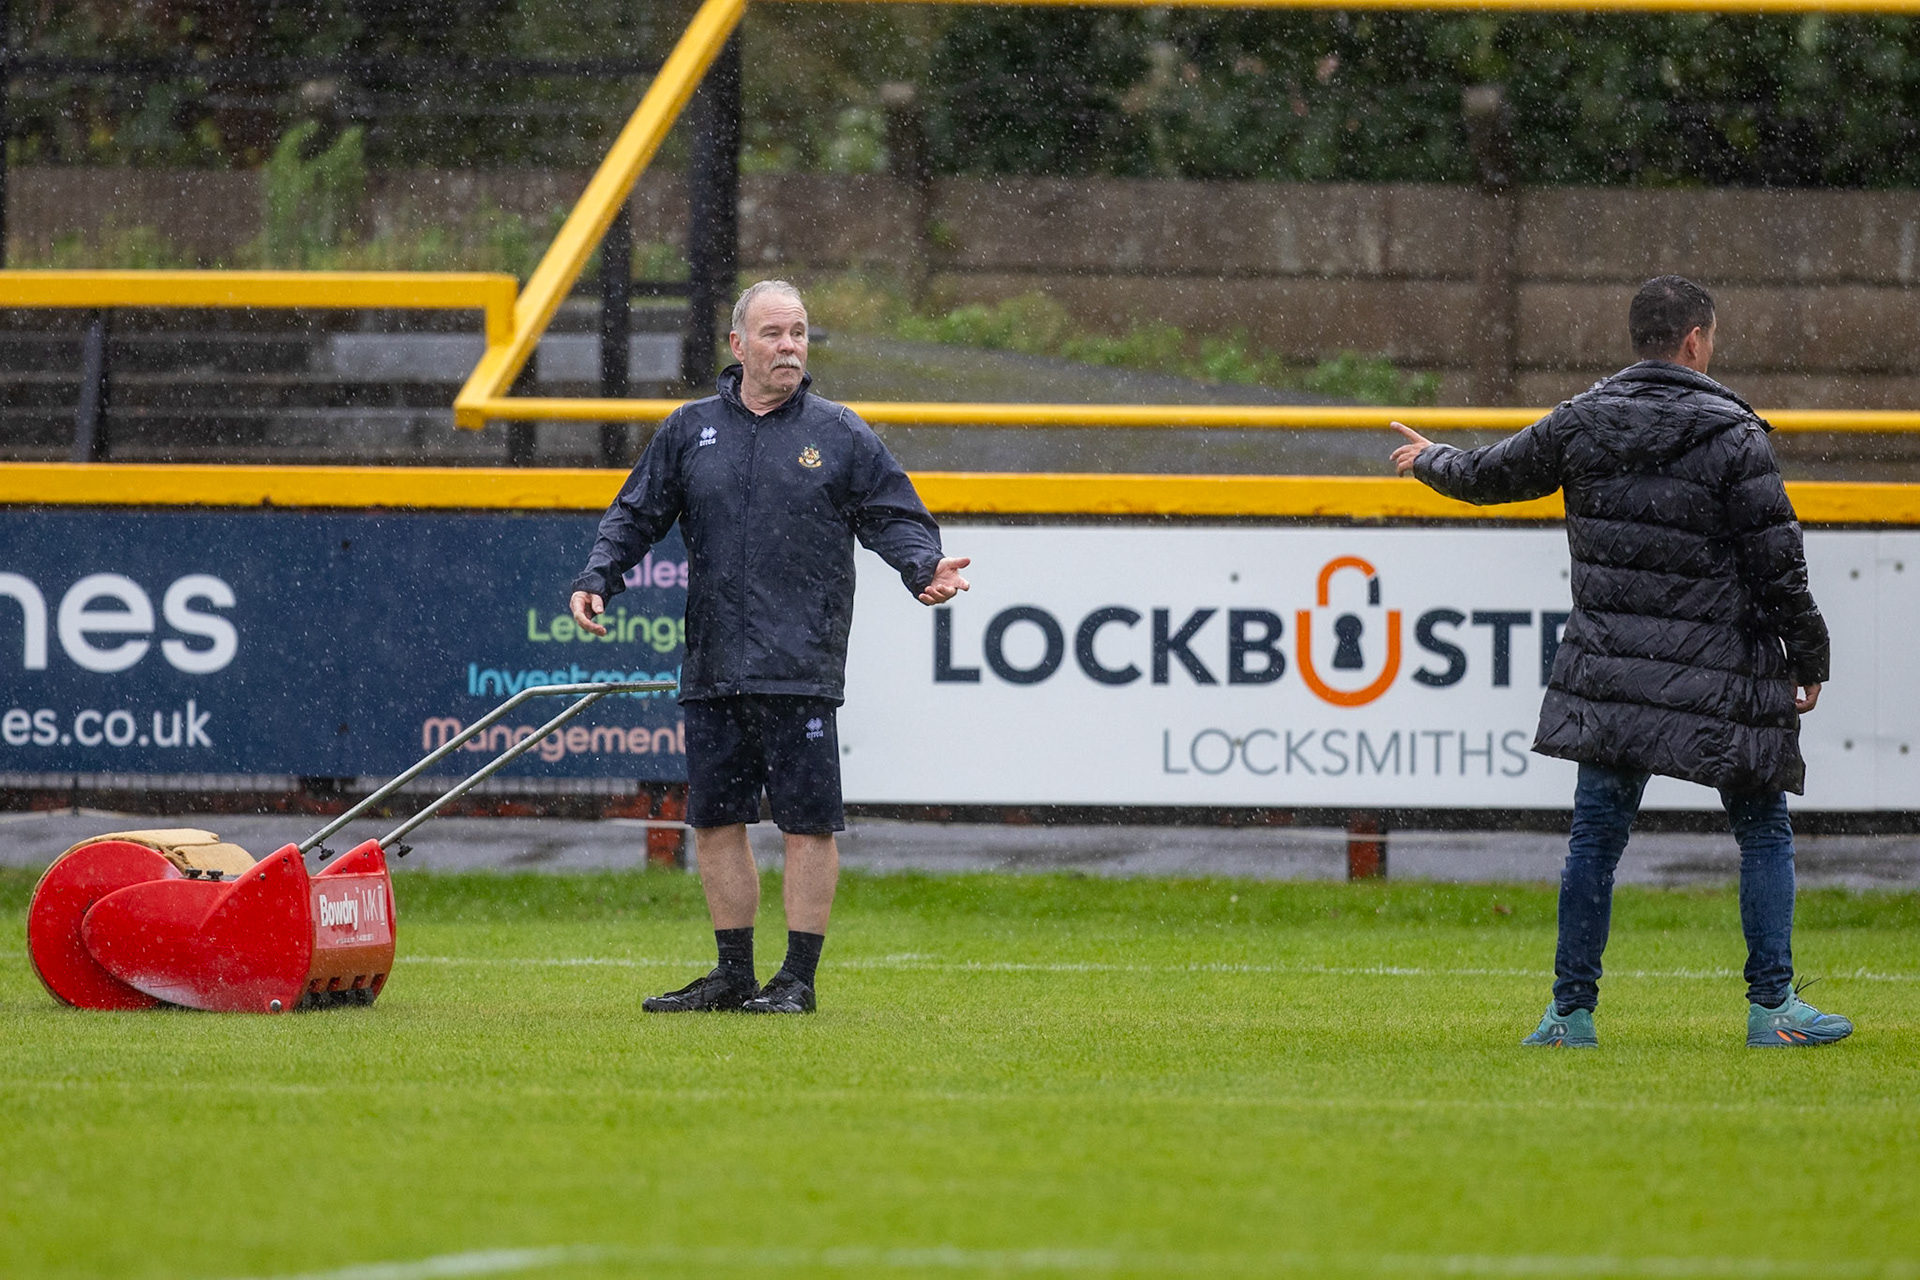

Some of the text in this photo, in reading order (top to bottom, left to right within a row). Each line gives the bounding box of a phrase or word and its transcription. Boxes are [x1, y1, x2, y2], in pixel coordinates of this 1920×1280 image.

[621, 550, 688, 589] ales
[1, 700, 213, 748] es.co.uk
[1162, 728, 1529, 778] LOCKSMITHS
